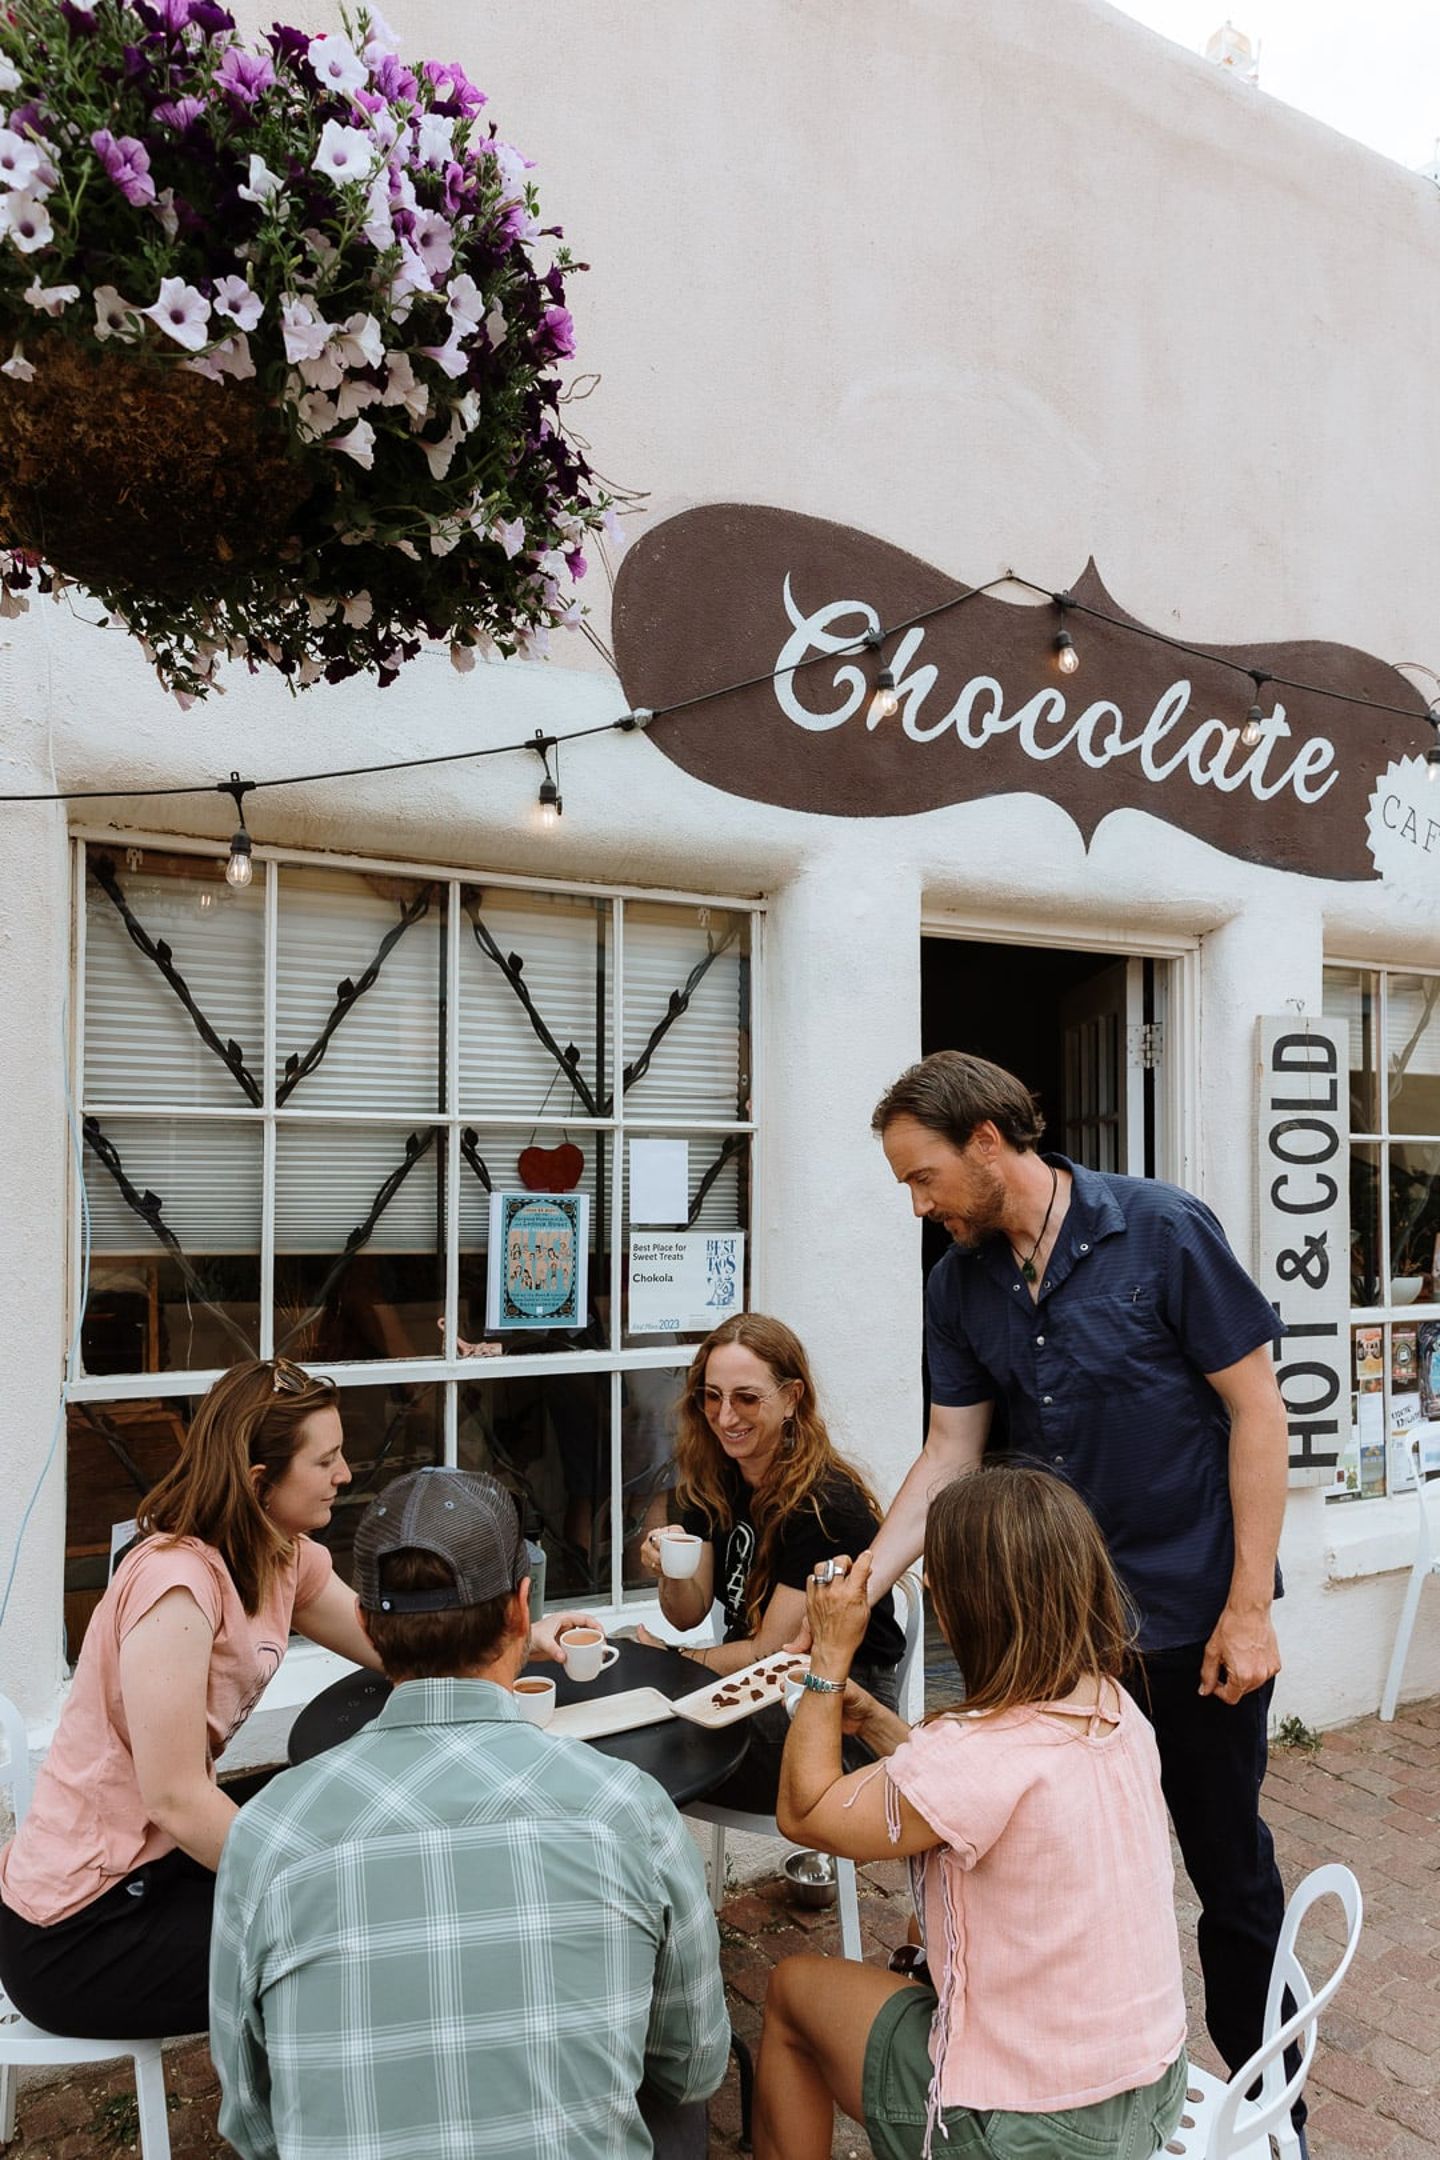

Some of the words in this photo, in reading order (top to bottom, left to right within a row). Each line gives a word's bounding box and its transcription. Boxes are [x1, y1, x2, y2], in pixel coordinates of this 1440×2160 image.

[773, 572, 1340, 805] Chocolate
[1269, 1033, 1339, 1215] COLD
[633, 1243, 650, 1251] Best
[652, 1243, 674, 1251] Place
[675, 1243, 687, 1251] for
[705, 1239, 736, 1256] BEST
[633, 1252, 658, 1261] Sweet
[659, 1252, 684, 1261] Treats
[705, 1255, 736, 1275] TAOS
[1276, 1230, 1329, 1290] &
[632, 1273, 674, 1283] Chokola
[658, 1318, 680, 1330] 2023
[1272, 1302, 1341, 1469] HOT
